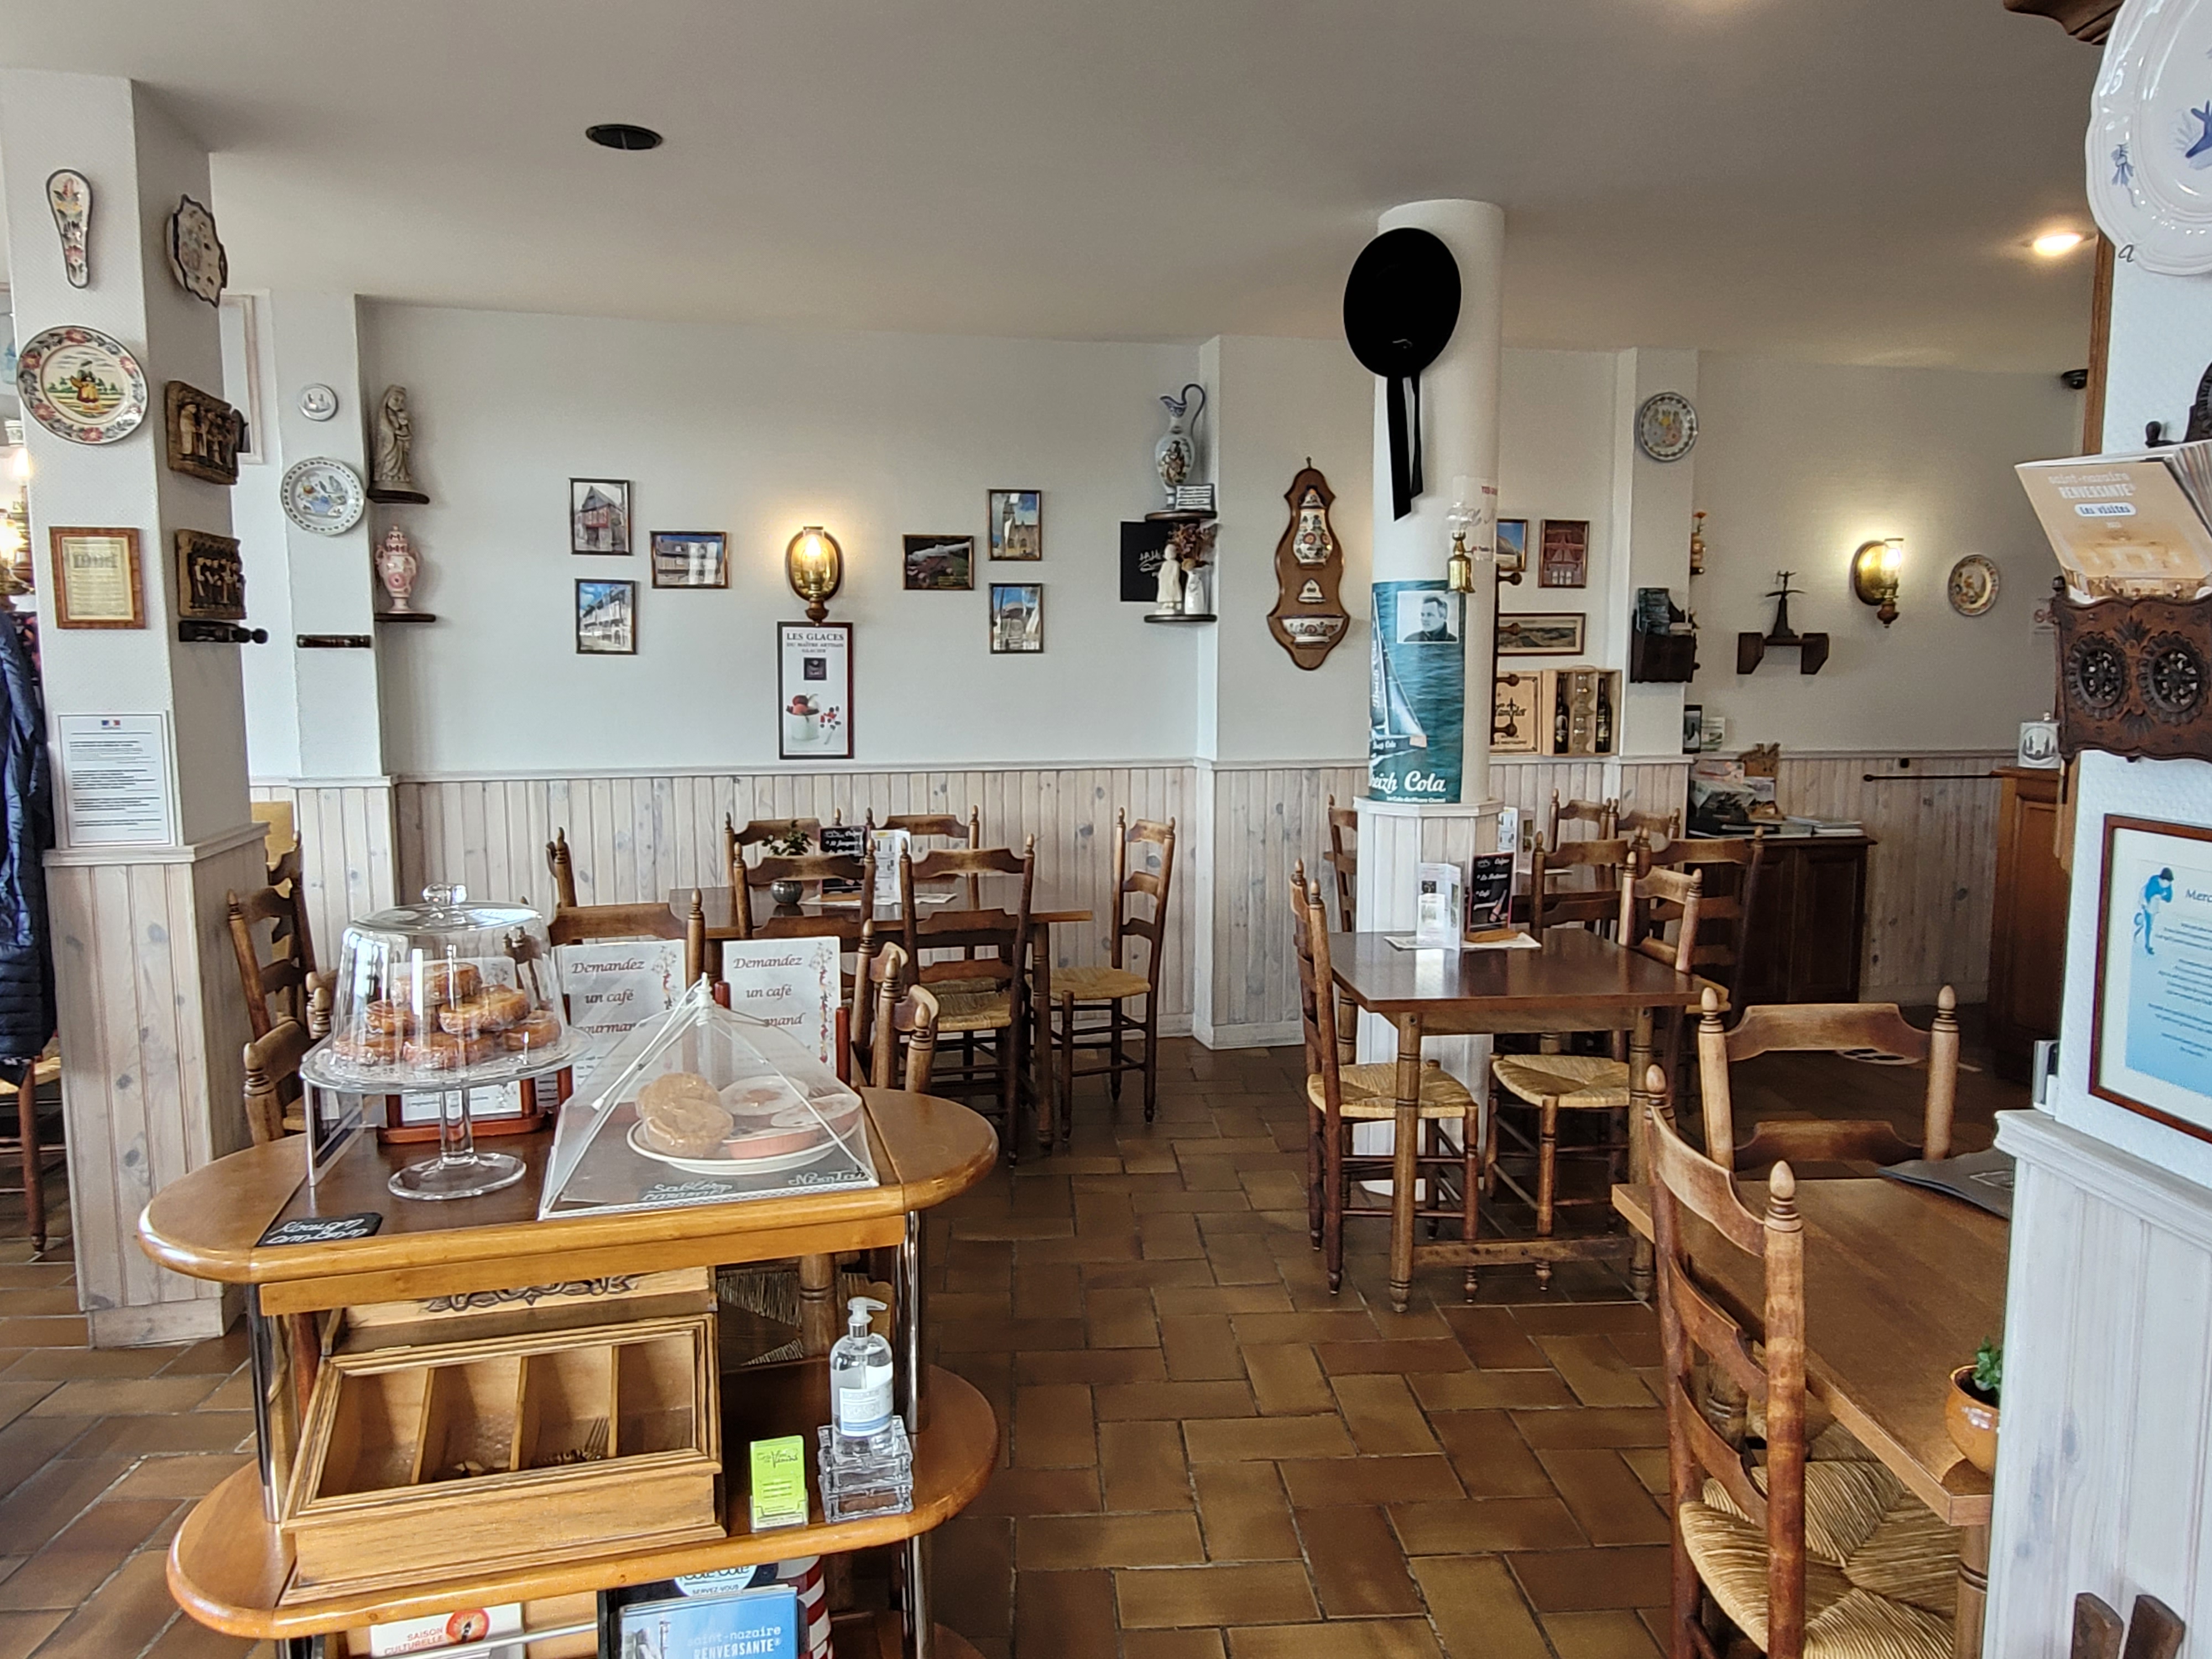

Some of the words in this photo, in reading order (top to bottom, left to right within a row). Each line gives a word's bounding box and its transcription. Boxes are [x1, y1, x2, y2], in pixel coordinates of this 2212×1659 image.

[2080, 506, 2095, 515] Les
[2098, 505, 2131, 514] visites
[806, 633, 844, 641] GLACES
[1404, 770, 1447, 792] Cola
[572, 957, 645, 974] Demandez
[733, 954, 803, 969] Demandez
[585, 993, 603, 1004] un
[606, 989, 634, 1005] café
[746, 989, 763, 998] un
[766, 984, 792, 1000] café
[407, 1626, 444, 1641] SAISON
[687, 1626, 782, 1647] saint-nazaire
[384, 1635, 443, 1656] CULTURELLE
